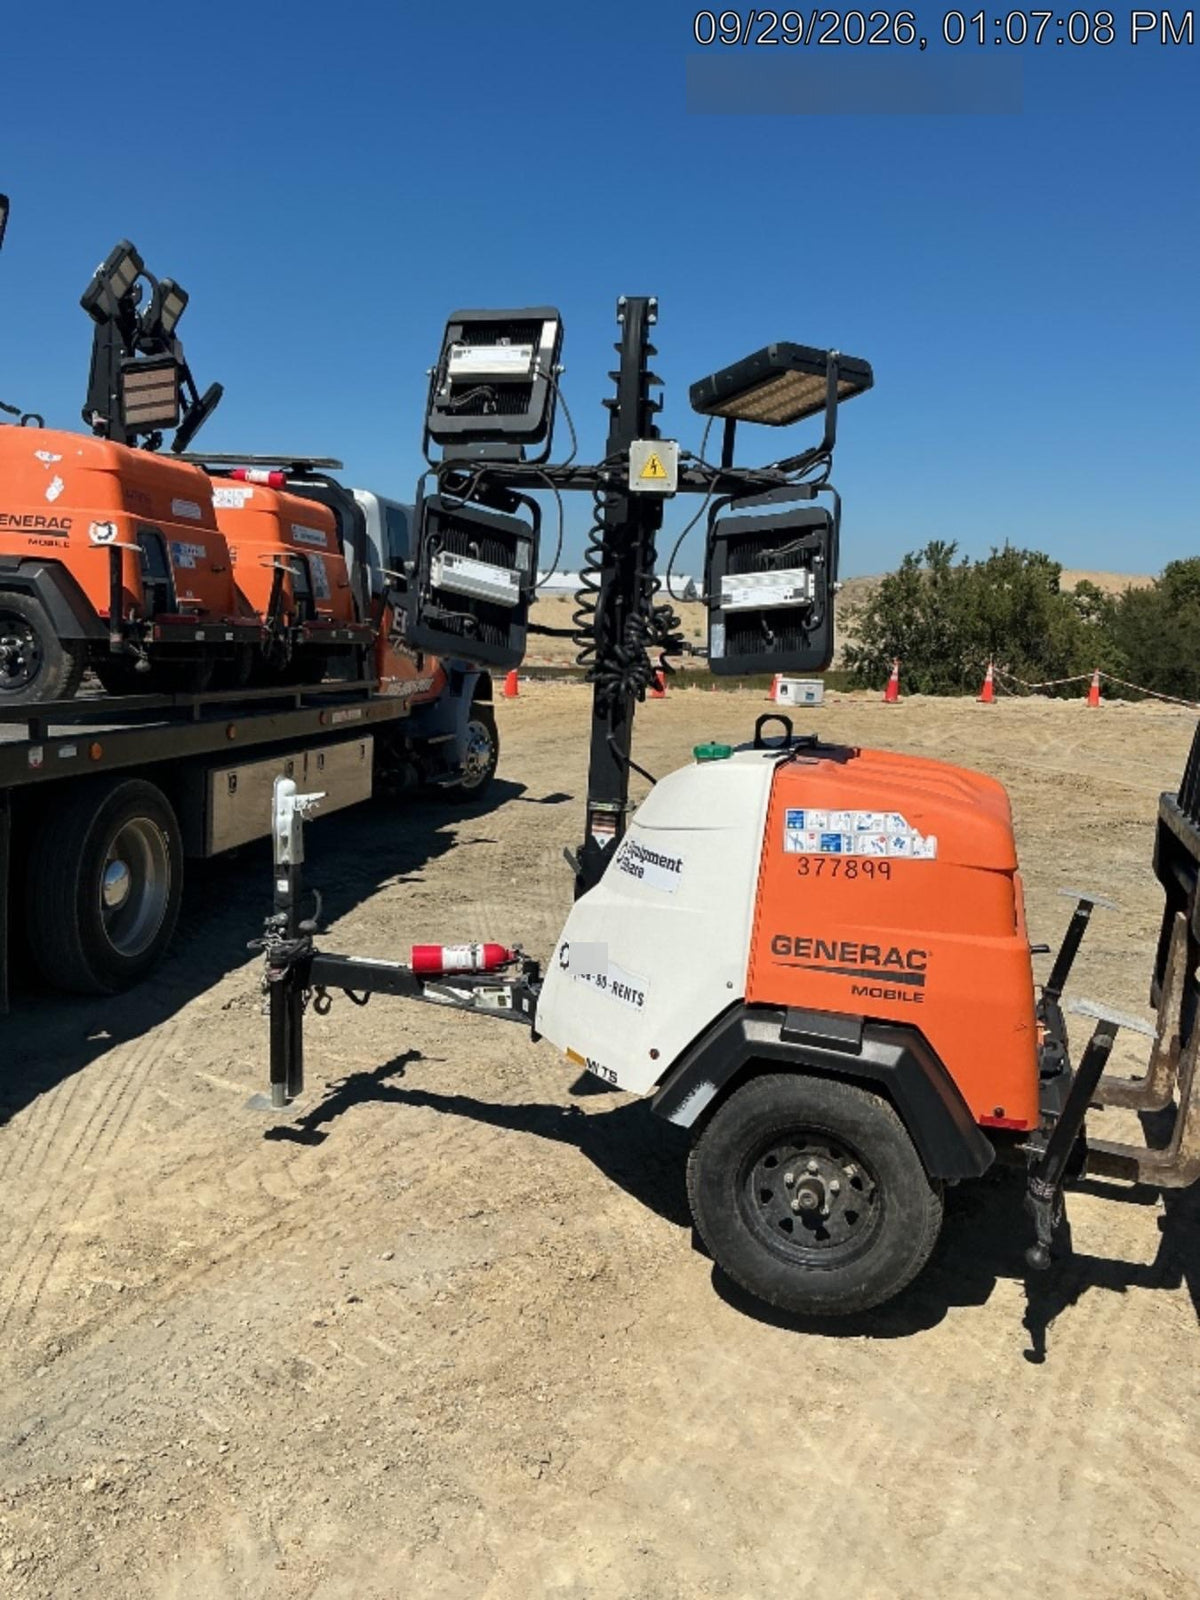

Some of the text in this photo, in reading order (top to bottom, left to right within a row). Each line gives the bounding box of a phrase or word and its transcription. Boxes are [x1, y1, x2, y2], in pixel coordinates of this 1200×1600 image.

[0, 513, 73, 530] ENERAC
[798, 856, 890, 880] 377899
[771, 934, 927, 971] GENERAC
[851, 985, 925, 1004] MOBILE
